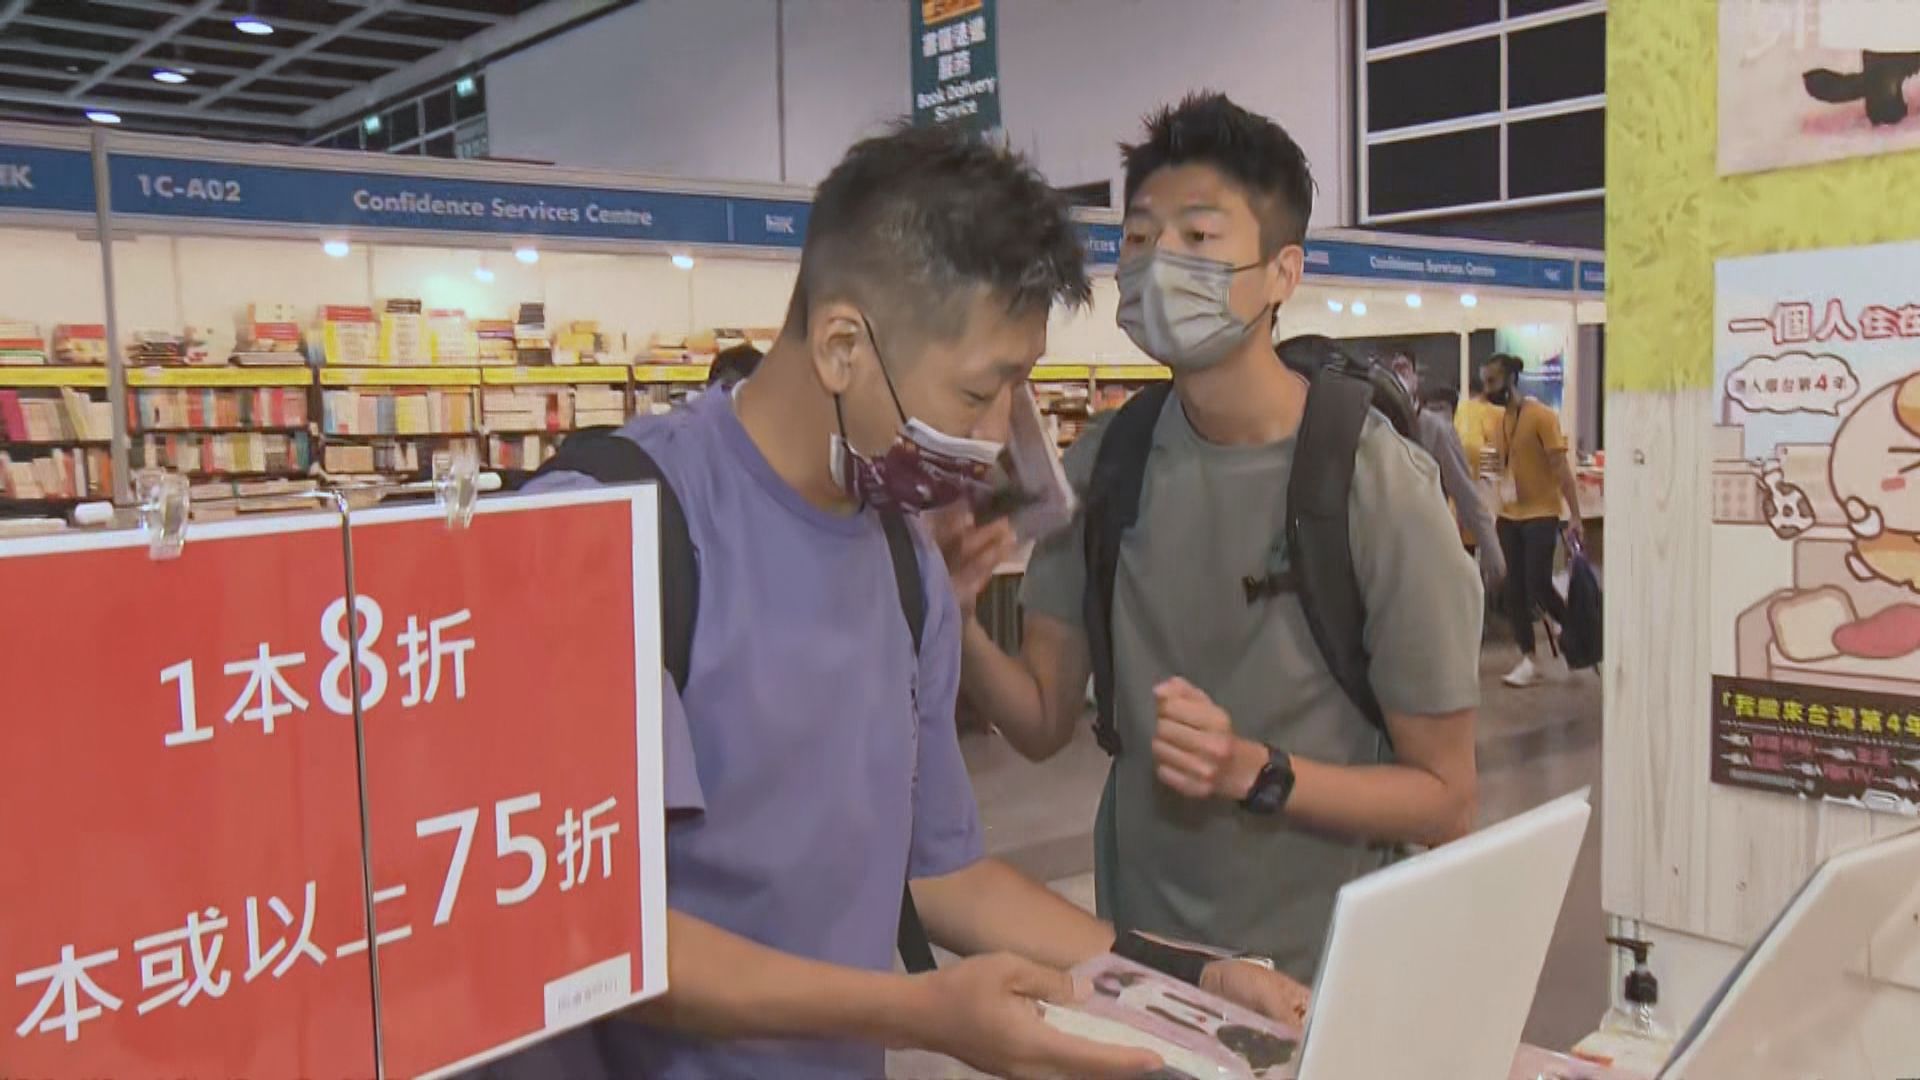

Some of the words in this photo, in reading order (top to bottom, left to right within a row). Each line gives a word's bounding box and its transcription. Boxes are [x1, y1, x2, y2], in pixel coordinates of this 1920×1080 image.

[917, 87, 946, 110] Book
[946, 76, 995, 100] Delivery
[934, 99, 978, 122] Service
[137, 172, 241, 202] 1C-A02
[353, 189, 486, 217] Confidence
[491, 197, 581, 223] Services
[585, 203, 654, 226] Centre
[160, 594, 475, 746] 1本8折
